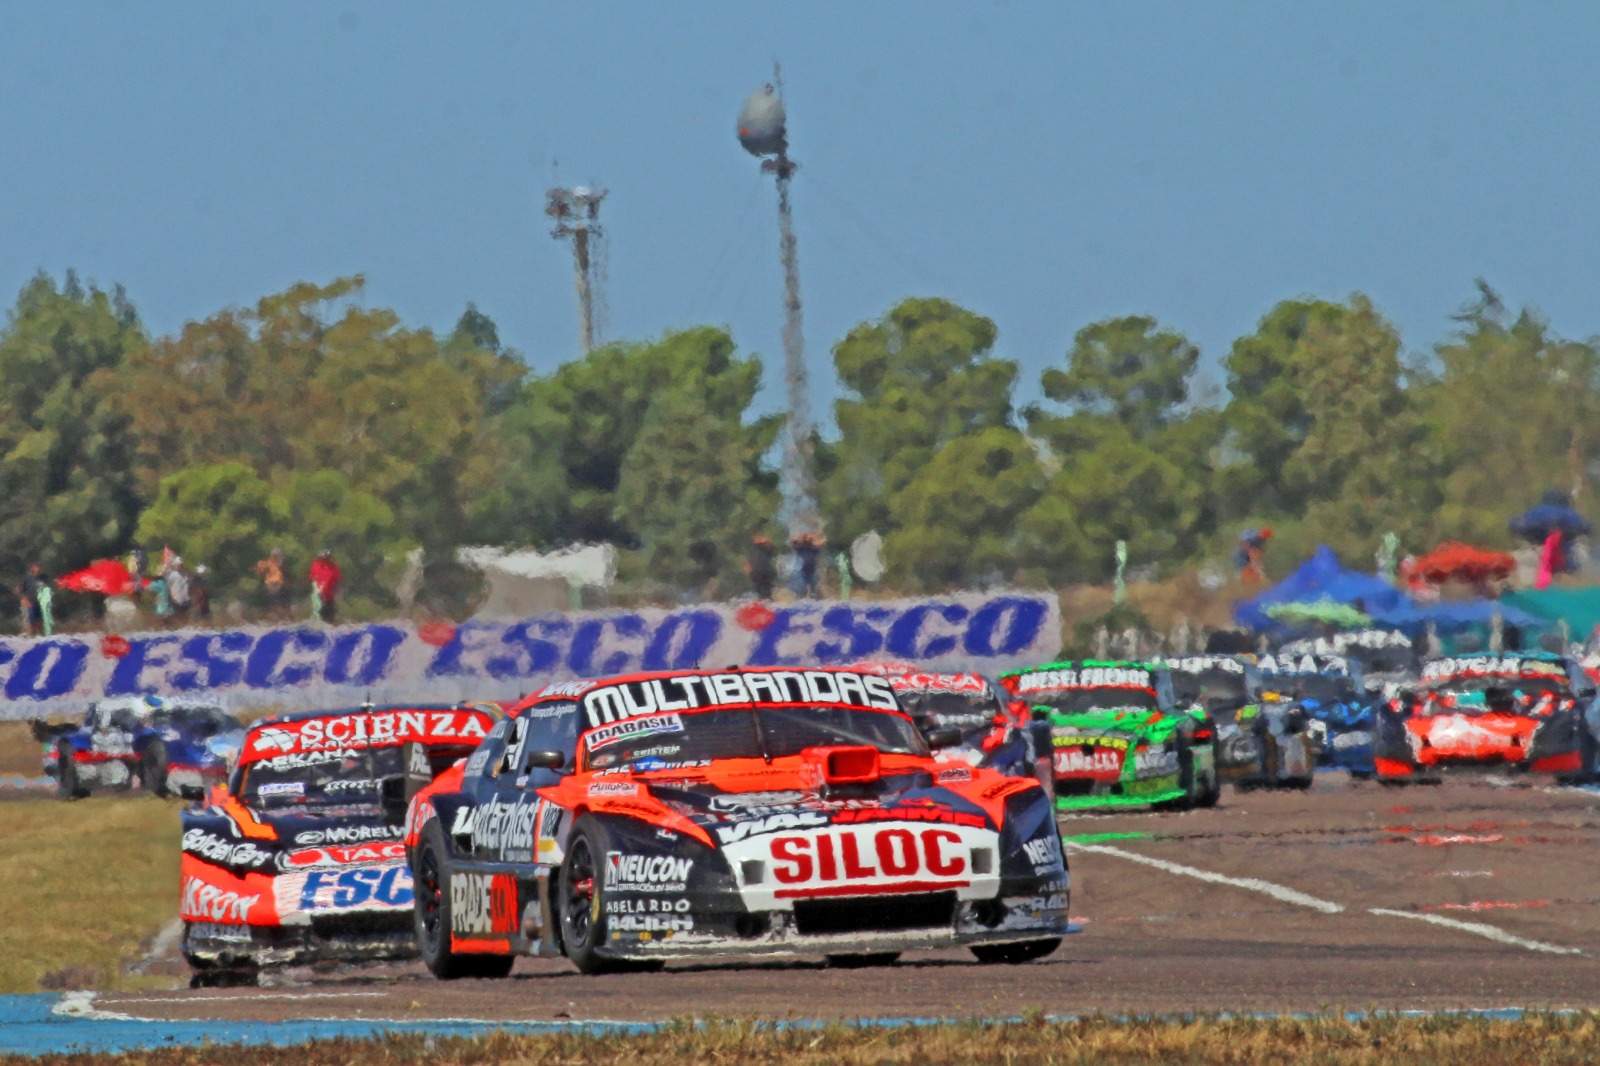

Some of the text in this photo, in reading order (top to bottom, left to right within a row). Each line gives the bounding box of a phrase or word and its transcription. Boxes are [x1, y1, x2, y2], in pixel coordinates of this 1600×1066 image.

[748, 594, 1050, 664] ESCO
[107, 624, 408, 698] ESCO
[584, 671, 898, 728] MULTIBANDAS
[300, 711, 488, 742] SCIENZA
[588, 716, 680, 744] TRABASIL
[618, 855, 694, 882] NEUCON
[770, 828, 966, 884] SILOC
[297, 866, 415, 911] ESC
[606, 899, 690, 913] ABELARDO
